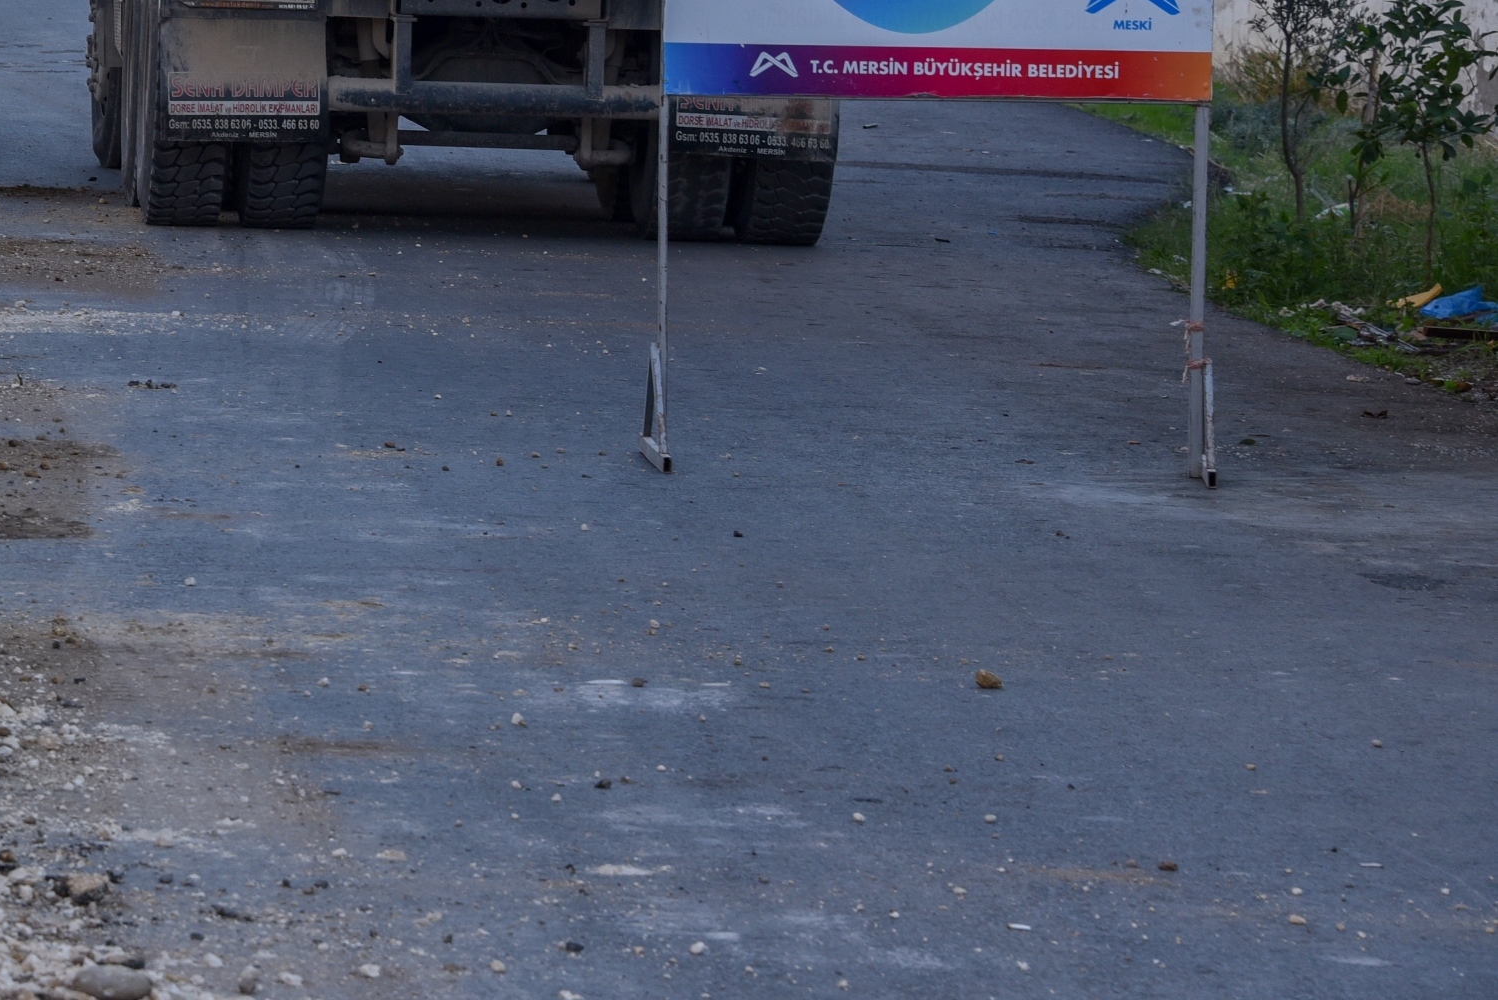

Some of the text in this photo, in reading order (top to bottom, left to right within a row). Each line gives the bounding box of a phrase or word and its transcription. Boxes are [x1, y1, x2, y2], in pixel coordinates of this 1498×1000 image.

[1112, 17, 1152, 31] MESKİ
[809, 56, 1120, 80] T.C. MERSİN BÜYÜKŞEHİR BELEDİYESİ
[171, 77, 317, 98] SENA DAMPER
[170, 103, 196, 114] DORSE
[197, 102, 224, 114] İMALAT
[232, 102, 267, 113] HİDROLİK
[268, 102, 318, 114] EKİPMANLARI
[168, 118, 190, 130] Gsm:
[192, 118, 213, 130] 0535.
[214, 118, 229, 130] 838
[230, 119, 241, 130] 63
[258, 119, 280, 130] 0533.
[281, 119, 297, 130] 466
[298, 119, 308, 130] 63
[309, 119, 320, 130] 60
[678, 115, 704, 126] DORSE
[705, 115, 733, 127] İMALAT
[248, 130, 278, 138] MERSİN
[675, 130, 697, 142] Gsm:
[699, 131, 720, 143] 0535.
[722, 132, 737, 144] 838
[738, 133, 749, 145] 63
[749, 134, 761, 146] 06
[767, 135, 789, 147] 0533.
[807, 138, 818, 149] 63
[717, 145, 747, 154] Akdeniz
[756, 147, 786, 156] MERSİN
